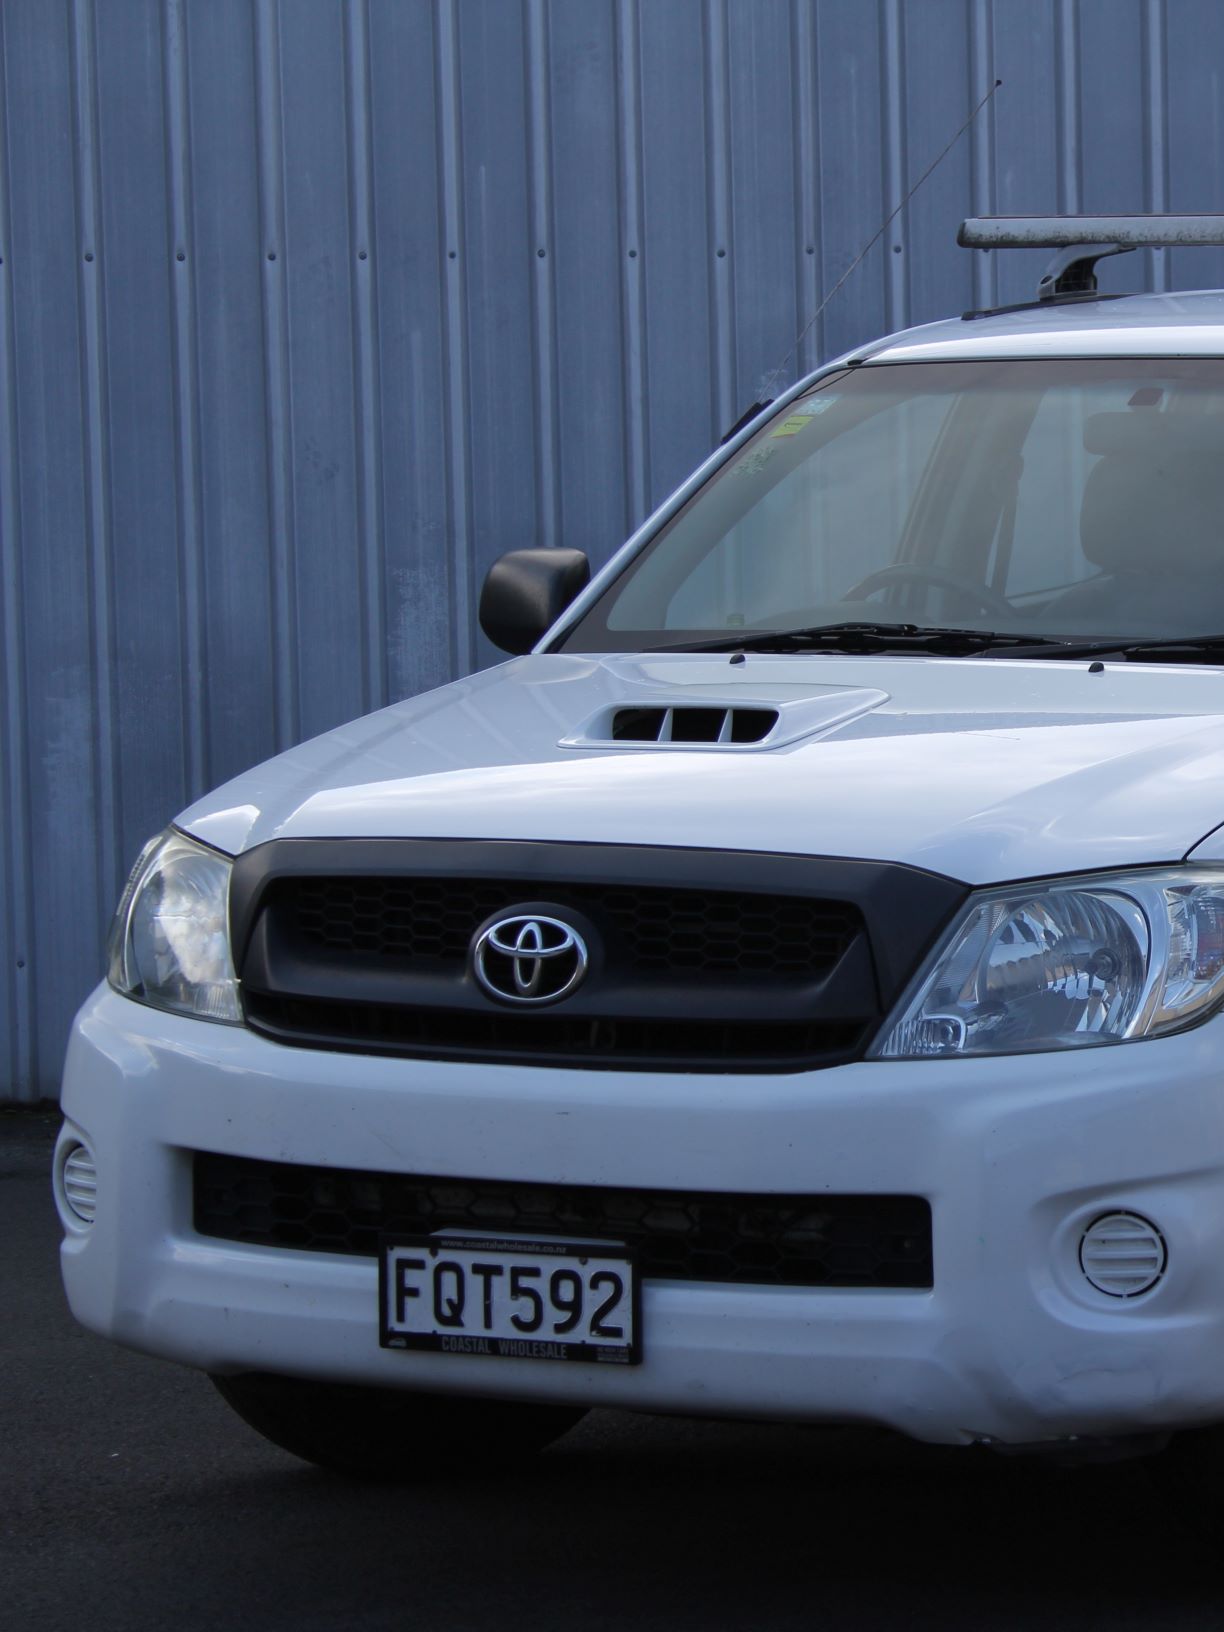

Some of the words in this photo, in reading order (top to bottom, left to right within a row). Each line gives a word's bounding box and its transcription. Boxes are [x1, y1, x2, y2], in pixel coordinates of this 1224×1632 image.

[395, 1258, 624, 1338] FQT592
[441, 1336, 491, 1354] COASTAL
[498, 1340, 568, 1359] WHOLESALE
